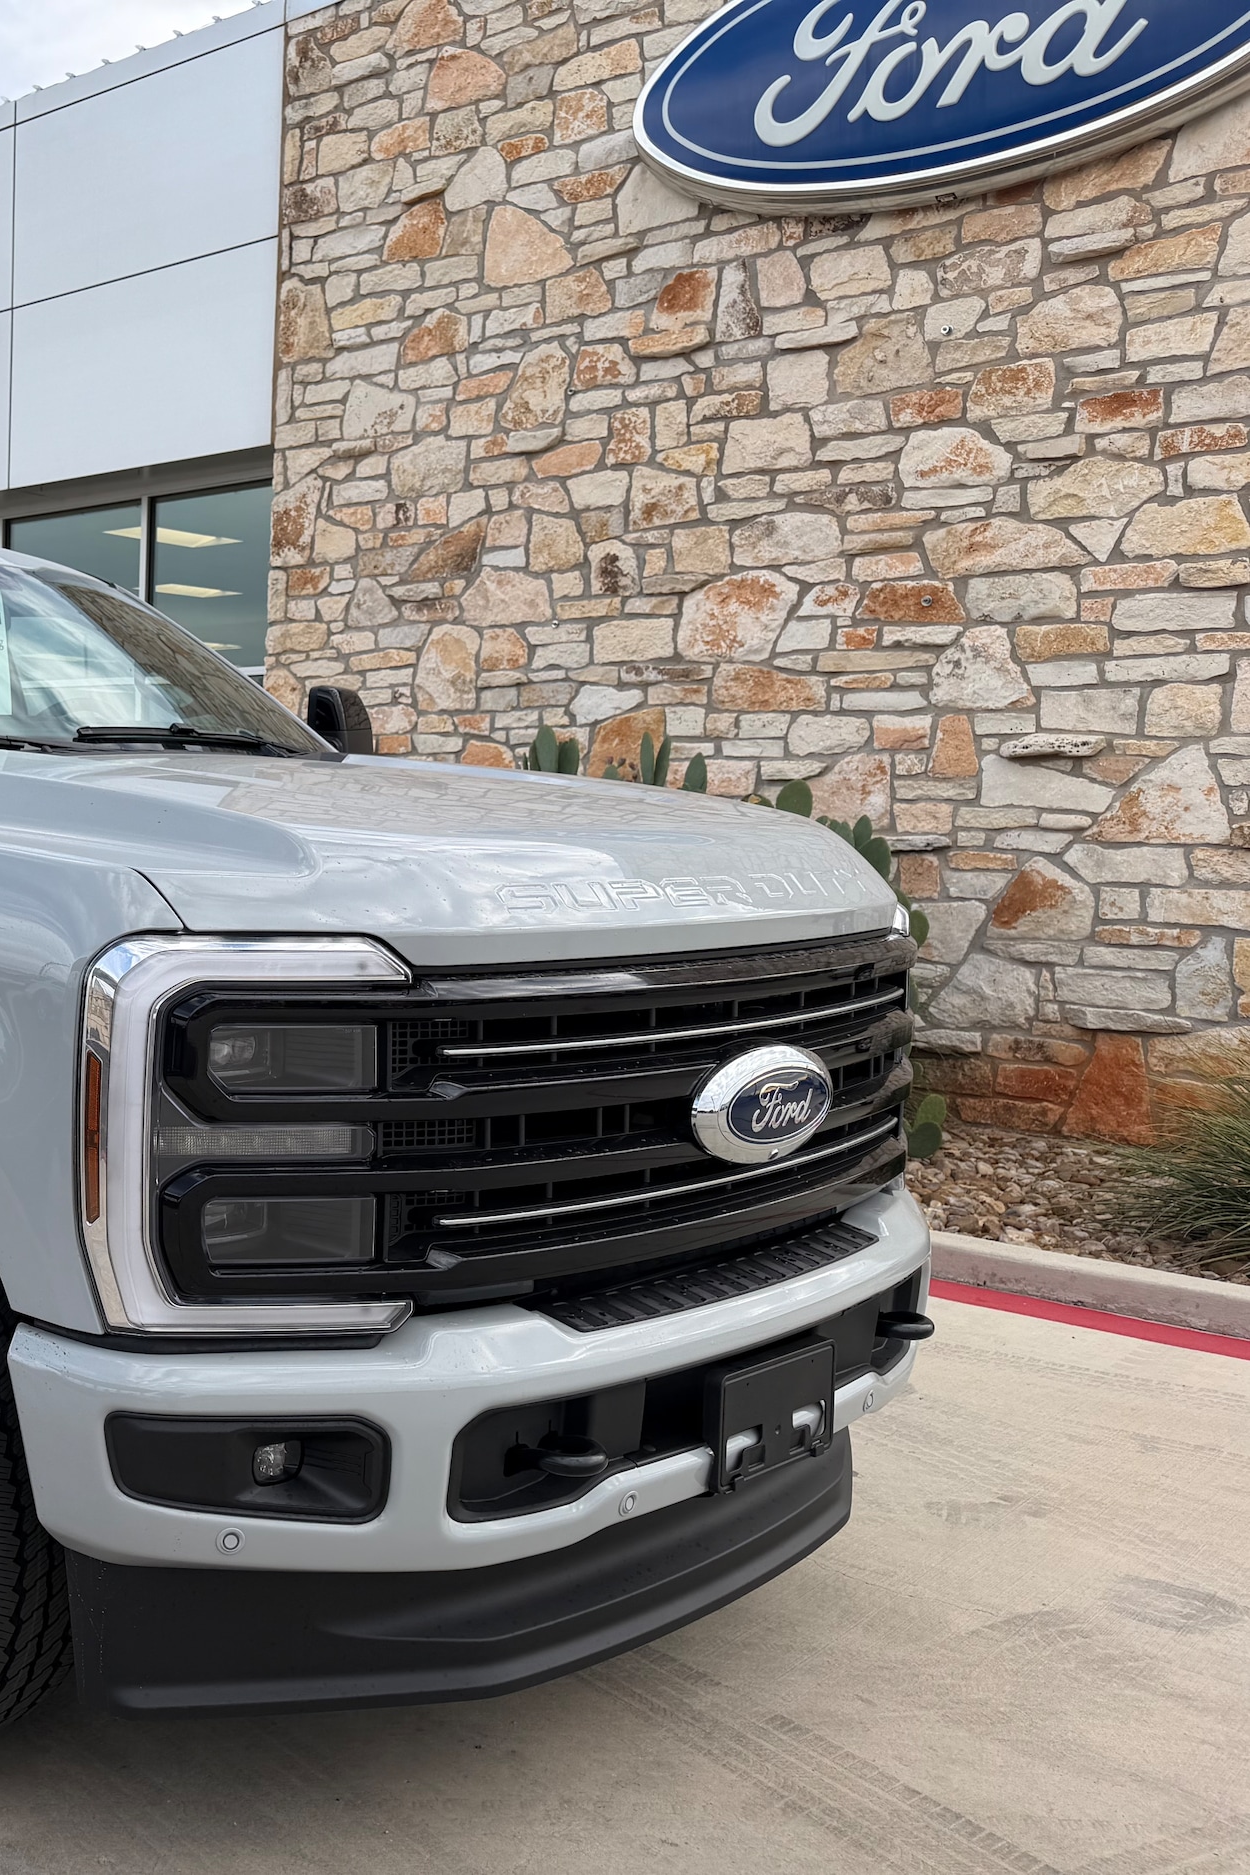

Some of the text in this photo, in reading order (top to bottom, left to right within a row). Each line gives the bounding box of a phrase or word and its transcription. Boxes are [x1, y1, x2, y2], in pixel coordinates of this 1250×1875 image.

[753, 0, 1148, 147] Ford
[495, 875, 753, 914] SUPER
[751, 1080, 814, 1133] Ford
